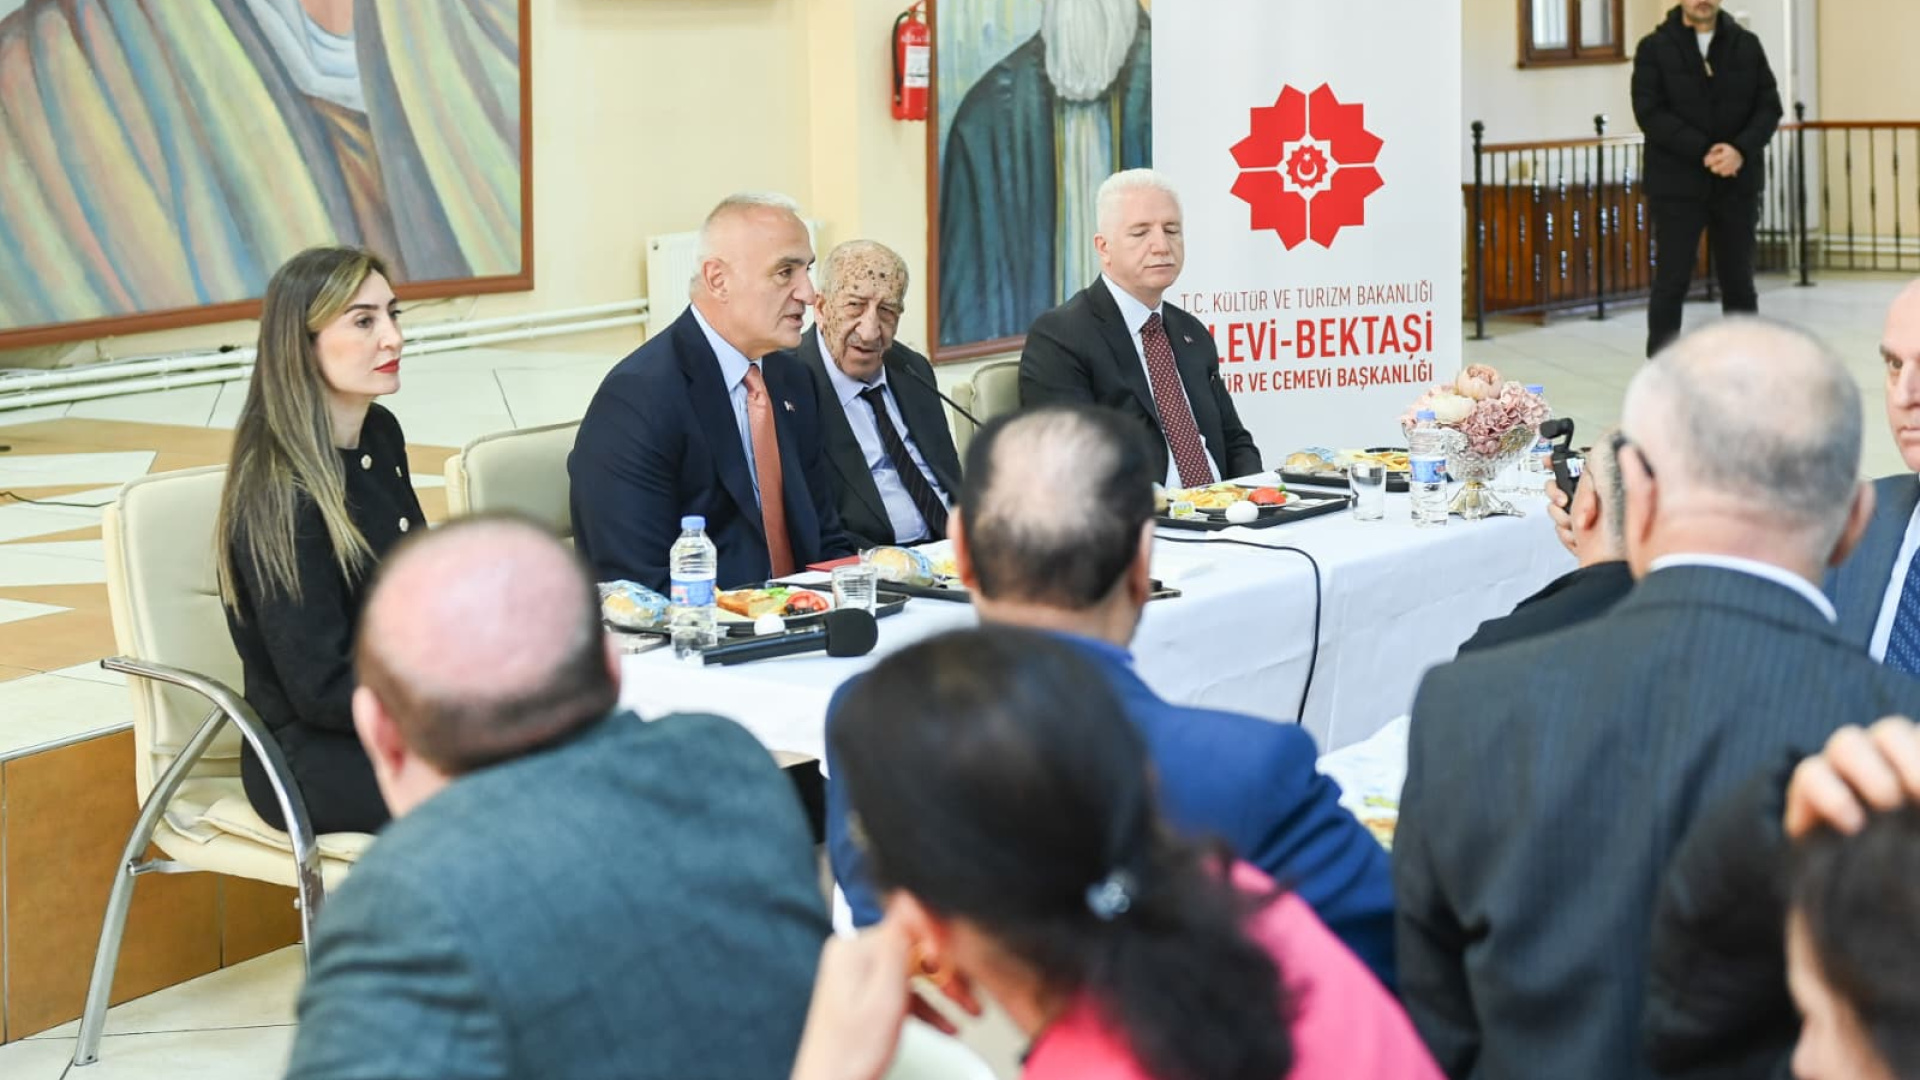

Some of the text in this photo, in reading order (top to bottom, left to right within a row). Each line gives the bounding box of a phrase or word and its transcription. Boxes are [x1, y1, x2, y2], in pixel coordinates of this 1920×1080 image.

[1213, 290, 1268, 313] KÜLTÜR
[1273, 288, 1291, 310] VE
[1297, 286, 1351, 308] TURİZM
[1357, 279, 1433, 306] BAKANLIĞI
[1248, 372, 1267, 392] VE
[1272, 368, 1332, 390] CEMEVİ
[1338, 359, 1433, 391] BAŞKANLIĞI
